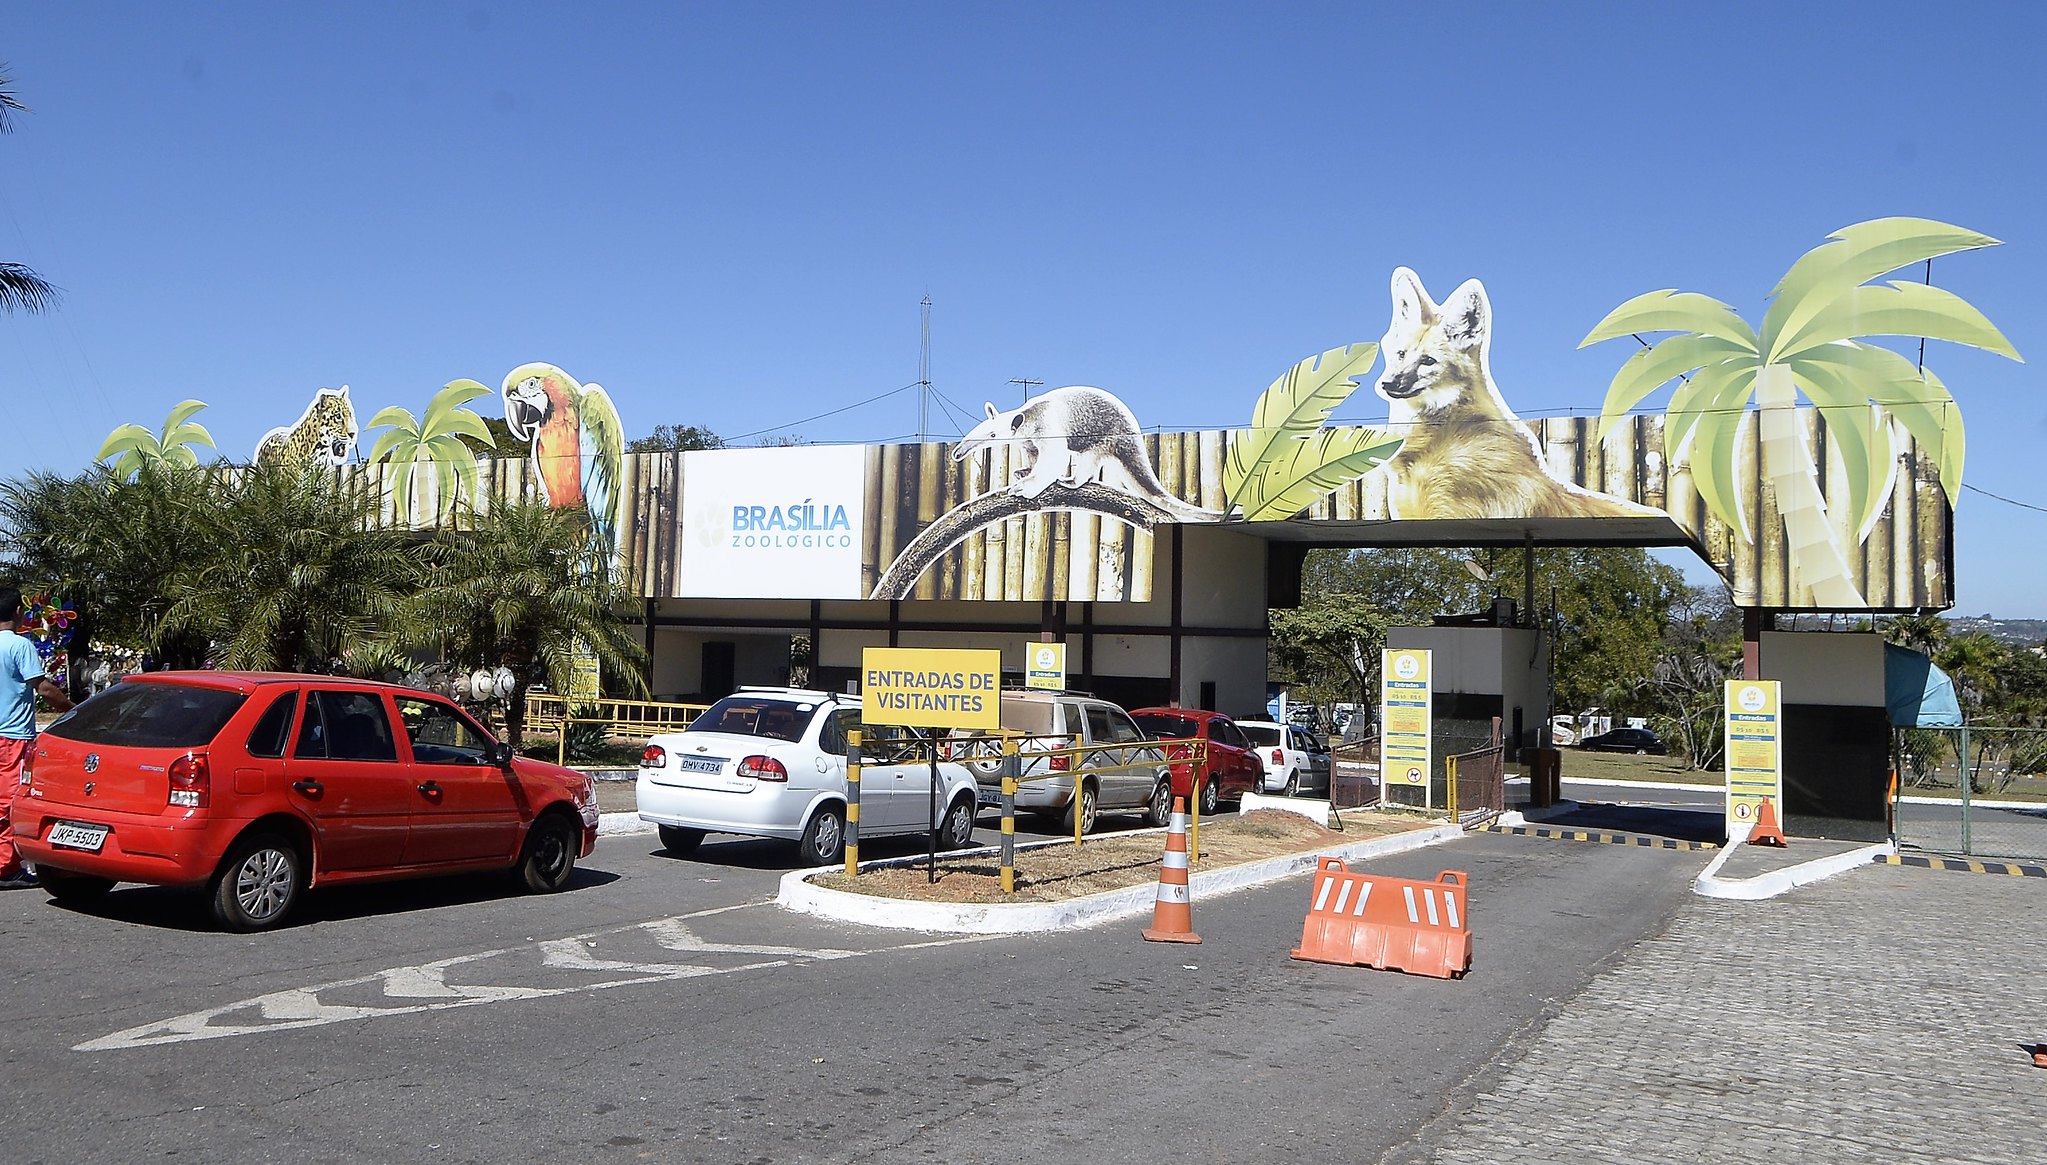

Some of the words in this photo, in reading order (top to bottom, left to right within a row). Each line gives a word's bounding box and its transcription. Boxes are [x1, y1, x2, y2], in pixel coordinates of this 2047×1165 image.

[733, 498, 851, 531] BRASÍLIA
[732, 534, 851, 548] ZOOLÓGICO
[867, 670, 964, 690] ENTRADAS
[969, 673, 994, 691] DE
[877, 692, 983, 713] VISITANTES
